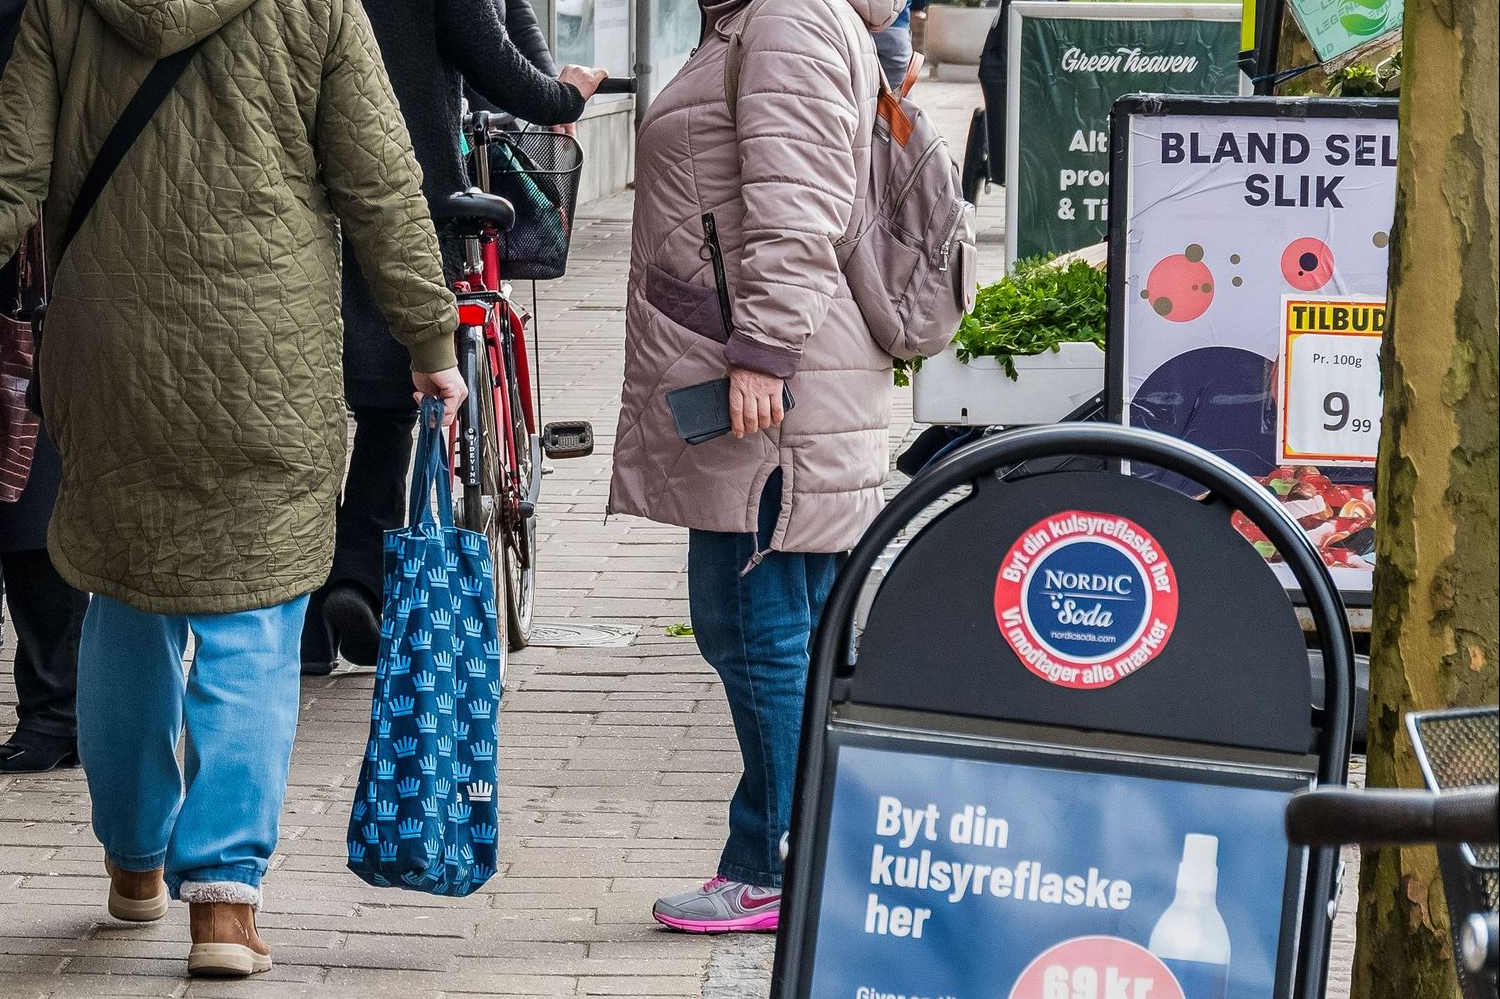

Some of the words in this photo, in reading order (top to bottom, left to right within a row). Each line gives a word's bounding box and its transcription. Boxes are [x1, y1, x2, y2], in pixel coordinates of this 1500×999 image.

[1062, 48, 1122, 73] Green
[1069, 130, 1108, 152] Alt
[1161, 132, 1311, 166] BLAND
[1244, 174, 1344, 209] SLIK
[1058, 198, 1075, 221] &
[1312, 352, 1329, 366] Pr.
[1333, 352, 1363, 369] 100g
[1322, 391, 1350, 431] 9
[1351, 418, 1372, 434] 99
[1002, 551, 1030, 583] Byt
[1024, 528, 1051, 555] din
[1048, 514, 1159, 565] kulsyreflaske
[1151, 561, 1172, 593] her
[1044, 569, 1133, 596] NORDIC
[1002, 606, 1023, 628] Vi
[1057, 599, 1114, 628] Soda
[1051, 631, 1117, 643] nordicsoda.com
[1116, 618, 1169, 677] mærker
[1009, 626, 1080, 683] modtager
[1082, 664, 1115, 684] alle
[877, 797, 938, 844] Byt
[950, 803, 1008, 849] din
[870, 845, 1133, 911] kulsyreflaske
[865, 893, 931, 939] her
[1043, 965, 1098, 999] 69
[1106, 967, 1154, 999] kr
